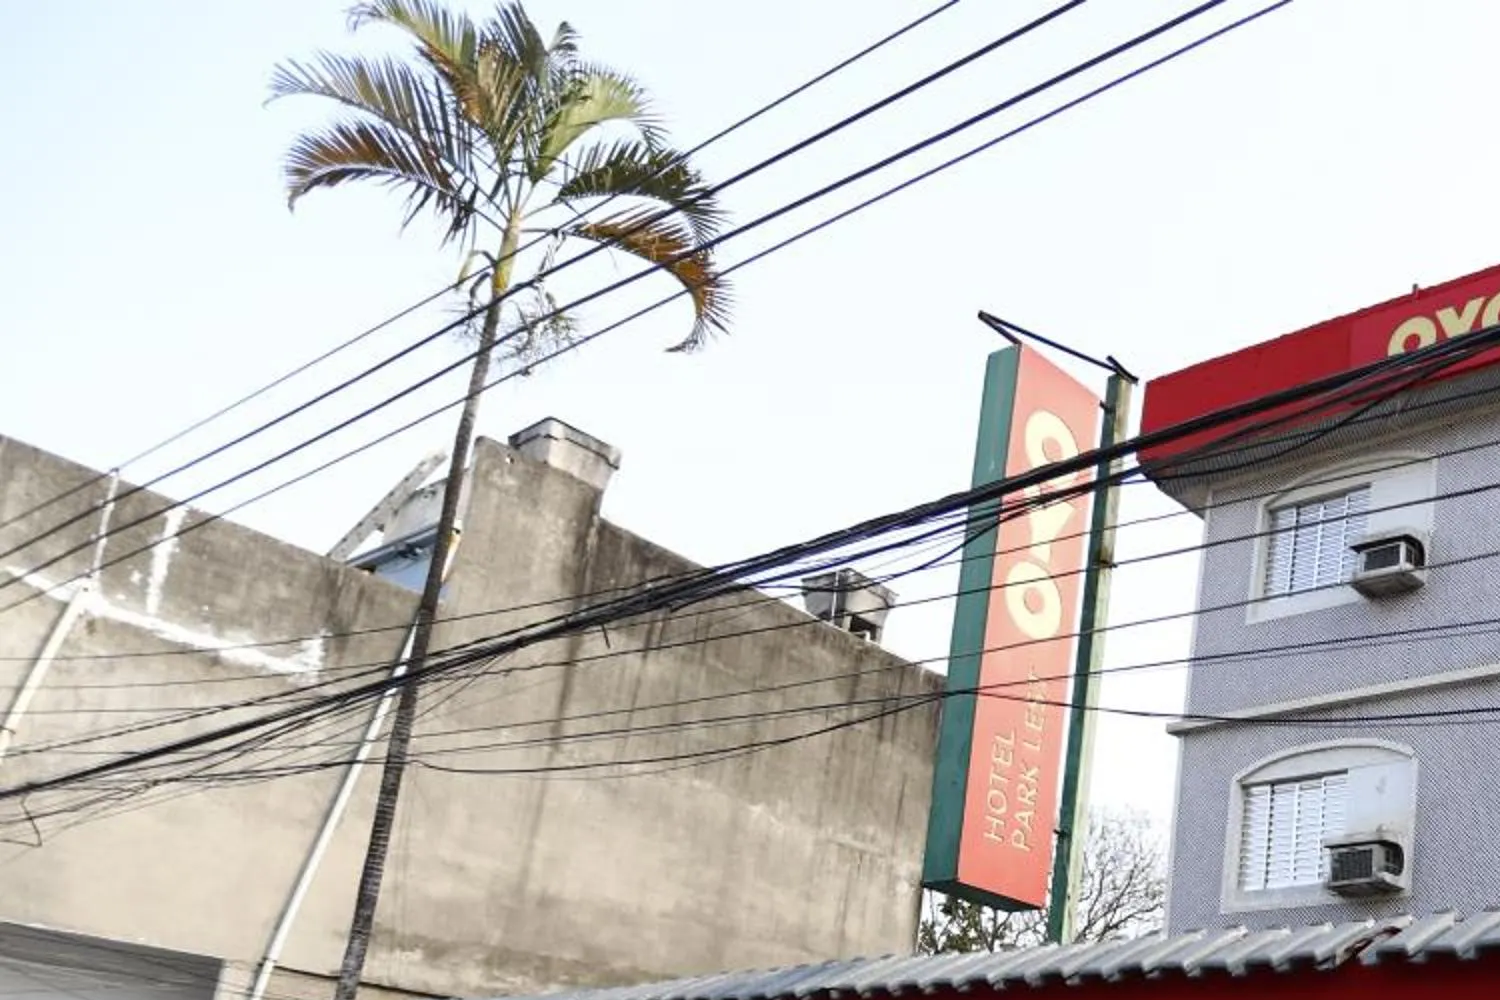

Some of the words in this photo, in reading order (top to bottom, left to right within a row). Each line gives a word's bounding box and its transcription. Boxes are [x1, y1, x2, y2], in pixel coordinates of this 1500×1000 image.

[1005, 410, 1079, 640] OYO
[983, 729, 1015, 843] HOTEL
[1010, 756, 1040, 851] PARK
